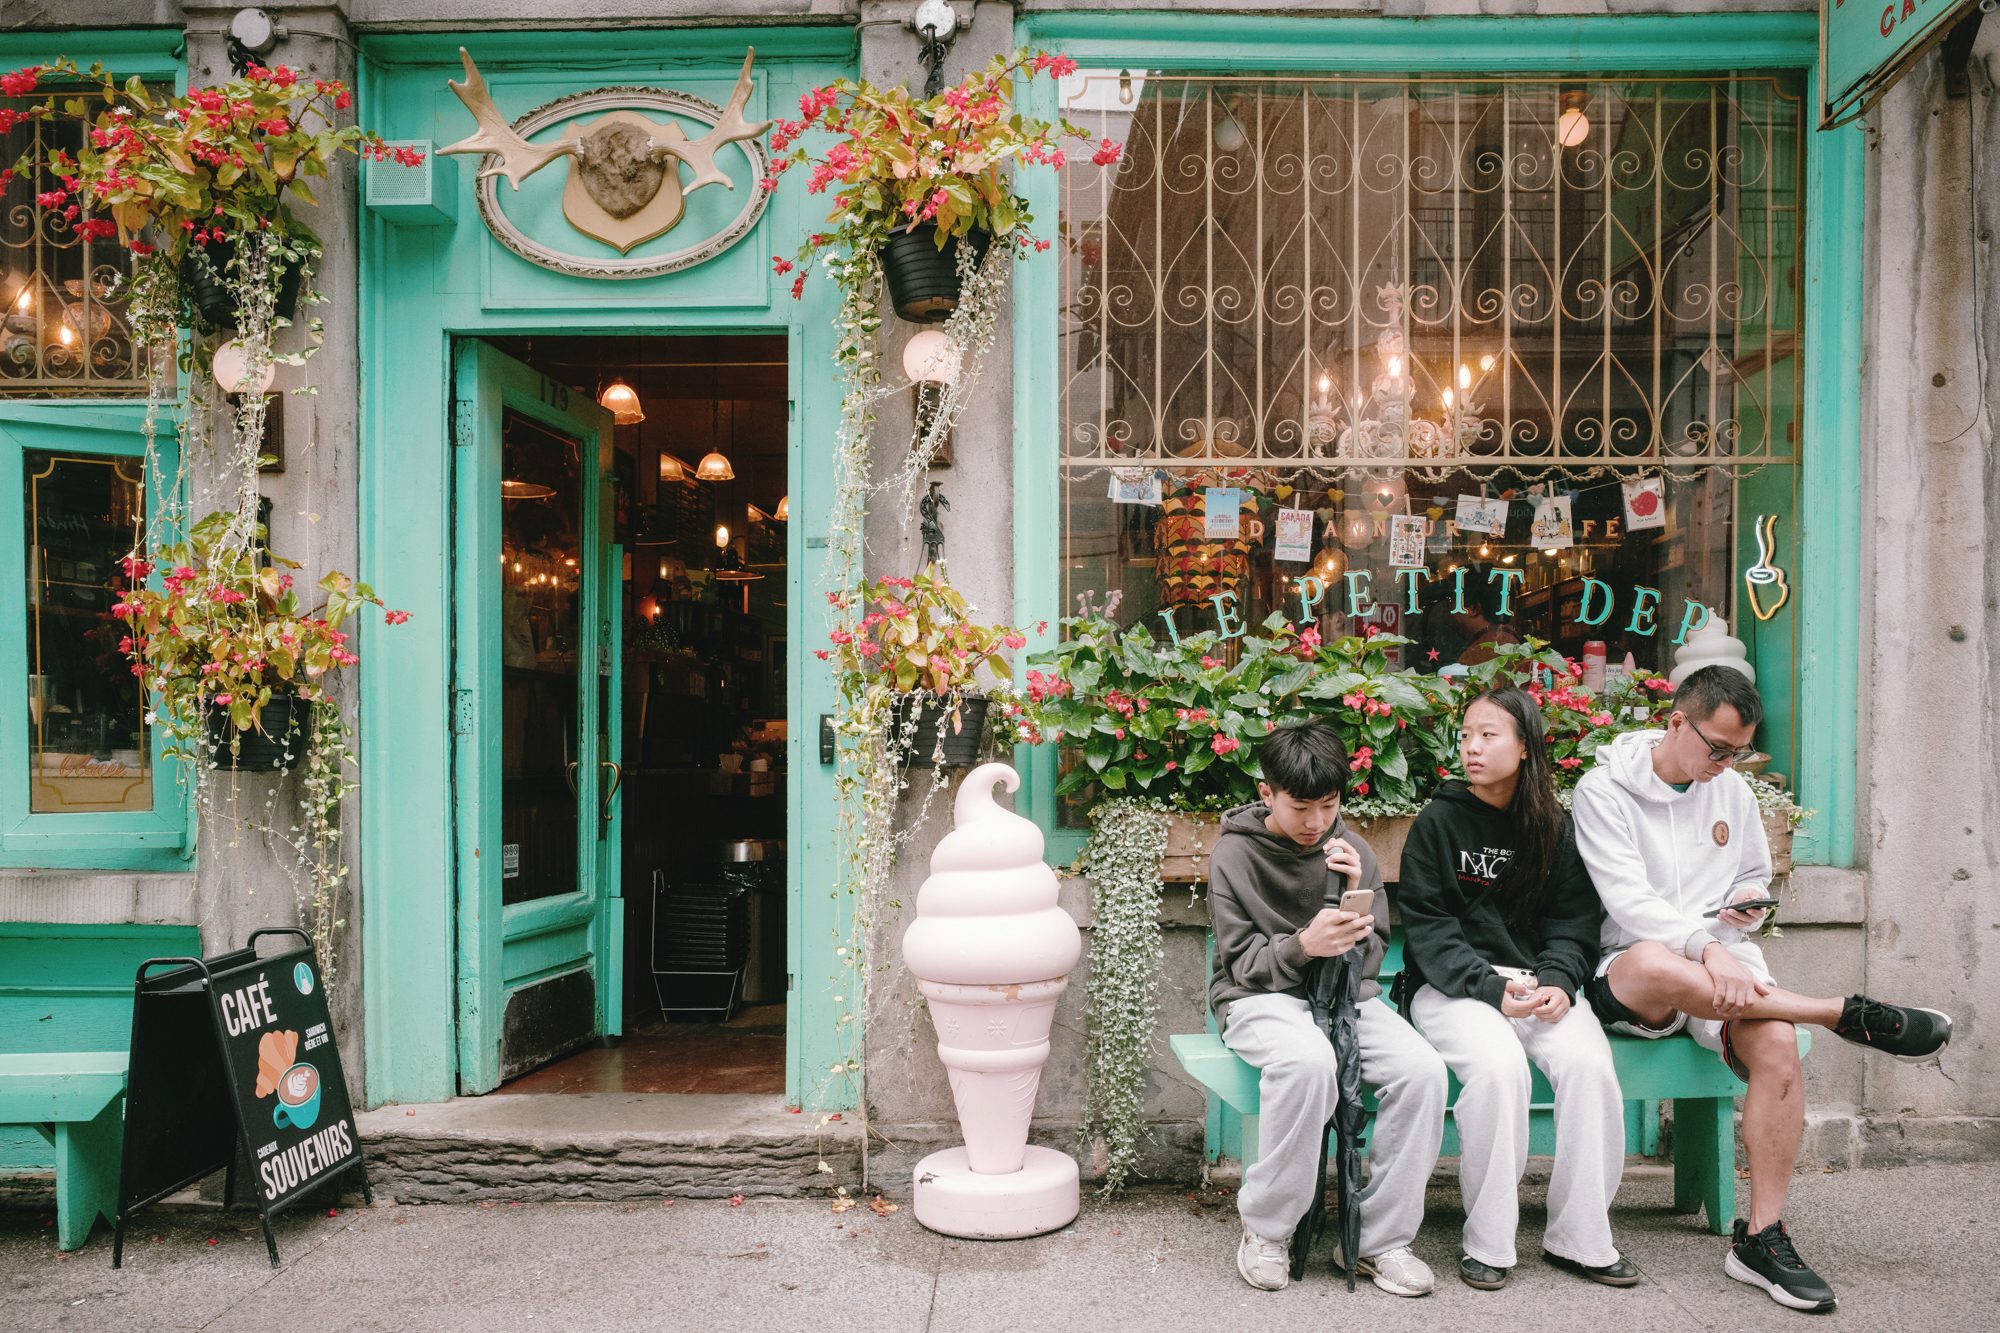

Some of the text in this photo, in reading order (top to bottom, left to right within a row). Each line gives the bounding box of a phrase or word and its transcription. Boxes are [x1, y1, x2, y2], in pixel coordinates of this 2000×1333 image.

[1880, 0, 1927, 38] CA
[540, 375, 569, 411] 179
[1280, 511, 1311, 522] CANADA
[1293, 566, 1527, 625] PETIT
[1574, 575, 1710, 647] DEP
[1483, 846, 1499, 855] THE
[220, 972, 278, 1037] CAFÉ
[256, 1140, 279, 1159] CADEAUX
[260, 1119, 353, 1201] SOUVENIRS
